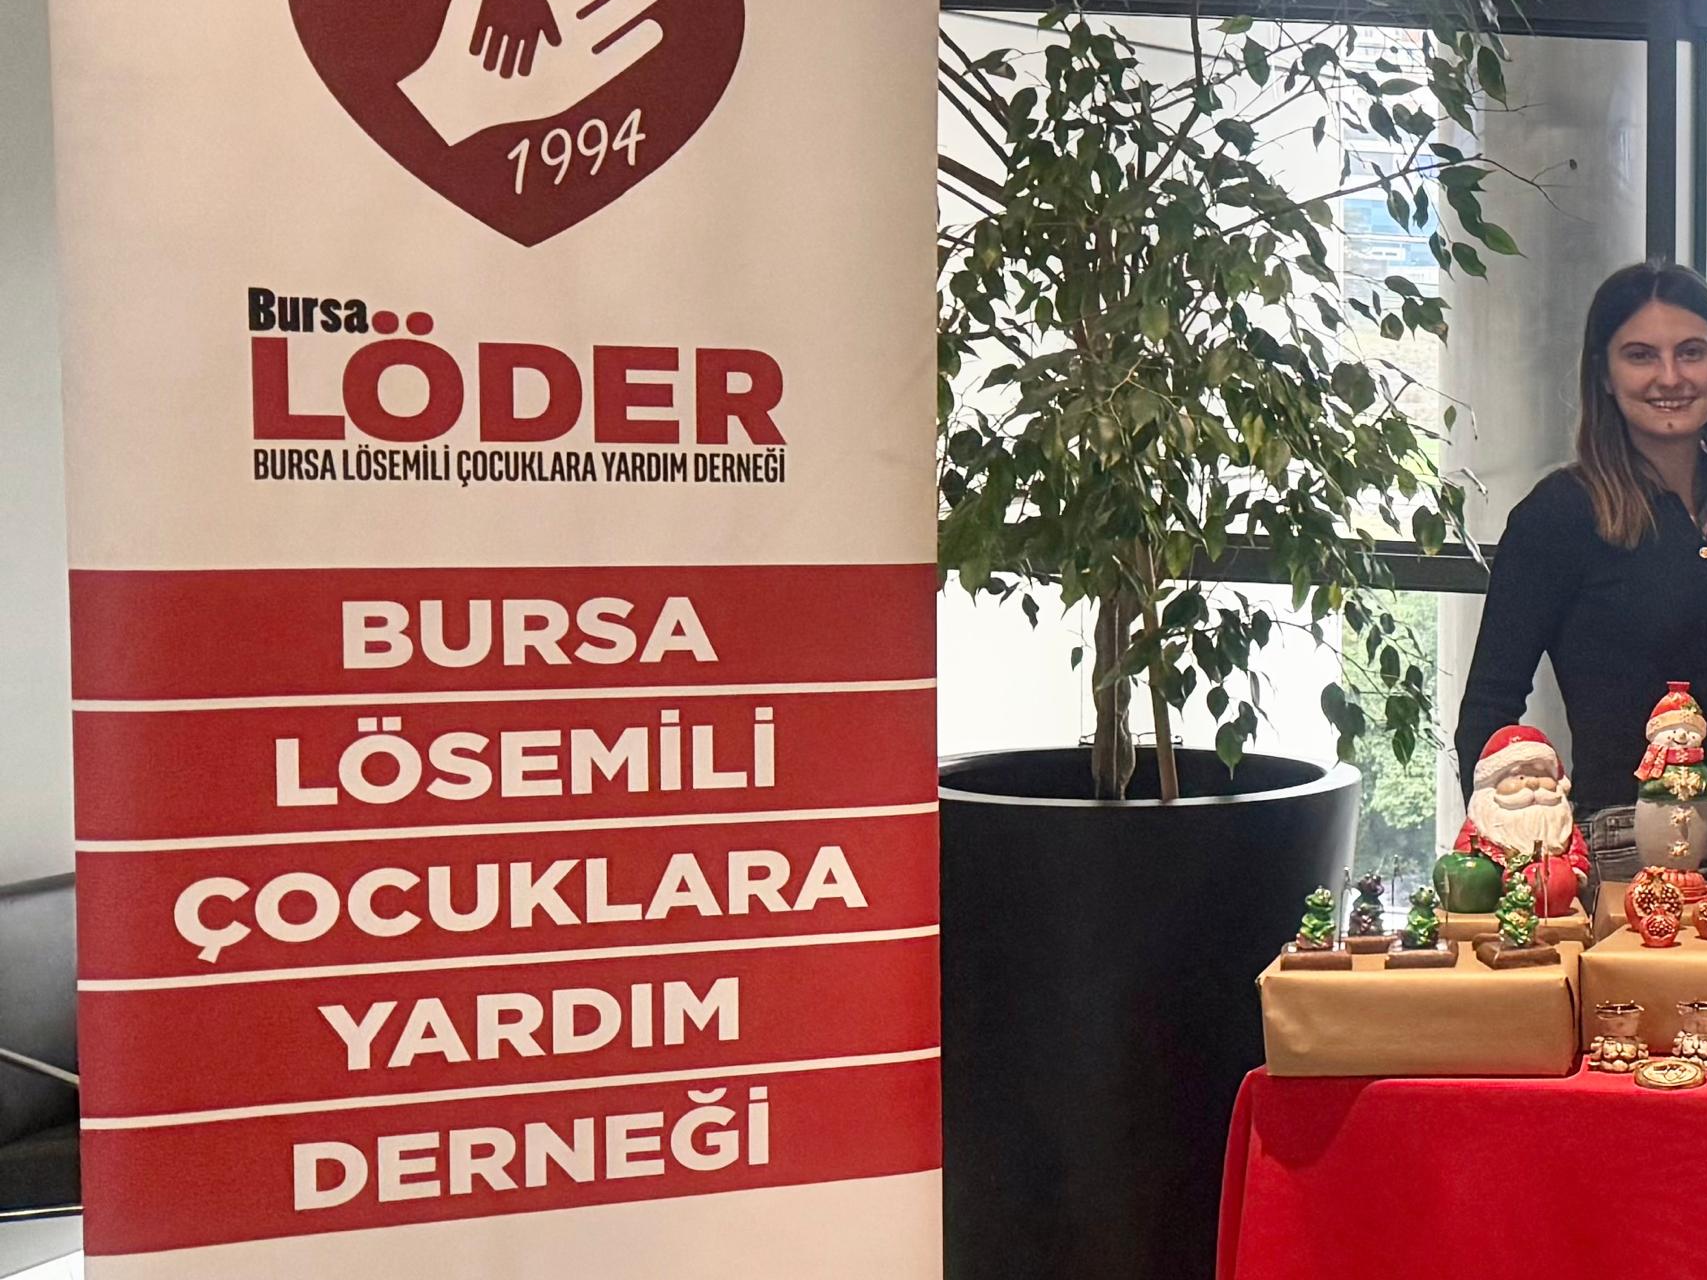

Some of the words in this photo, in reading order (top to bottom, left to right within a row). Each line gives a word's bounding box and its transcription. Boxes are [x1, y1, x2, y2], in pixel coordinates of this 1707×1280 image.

[508, 108, 646, 195] 1994
[248, 287, 369, 333] Bursa
[251, 310, 786, 446] LÖDER
[253, 448, 337, 481] BURSA
[342, 444, 450, 481] LÖSEMİLİ
[456, 450, 597, 488] ÇOCUKLARA
[601, 451, 688, 483] YARDIM
[693, 447, 785, 483] DERNEĞİ
[342, 596, 718, 669] BURSA
[274, 706, 775, 807] LÖSEMİLİ
[173, 844, 869, 963] ÇOCUKLARA
[318, 975, 740, 1071] YARDIM
[292, 1085, 770, 1211] DERNEĞİ
